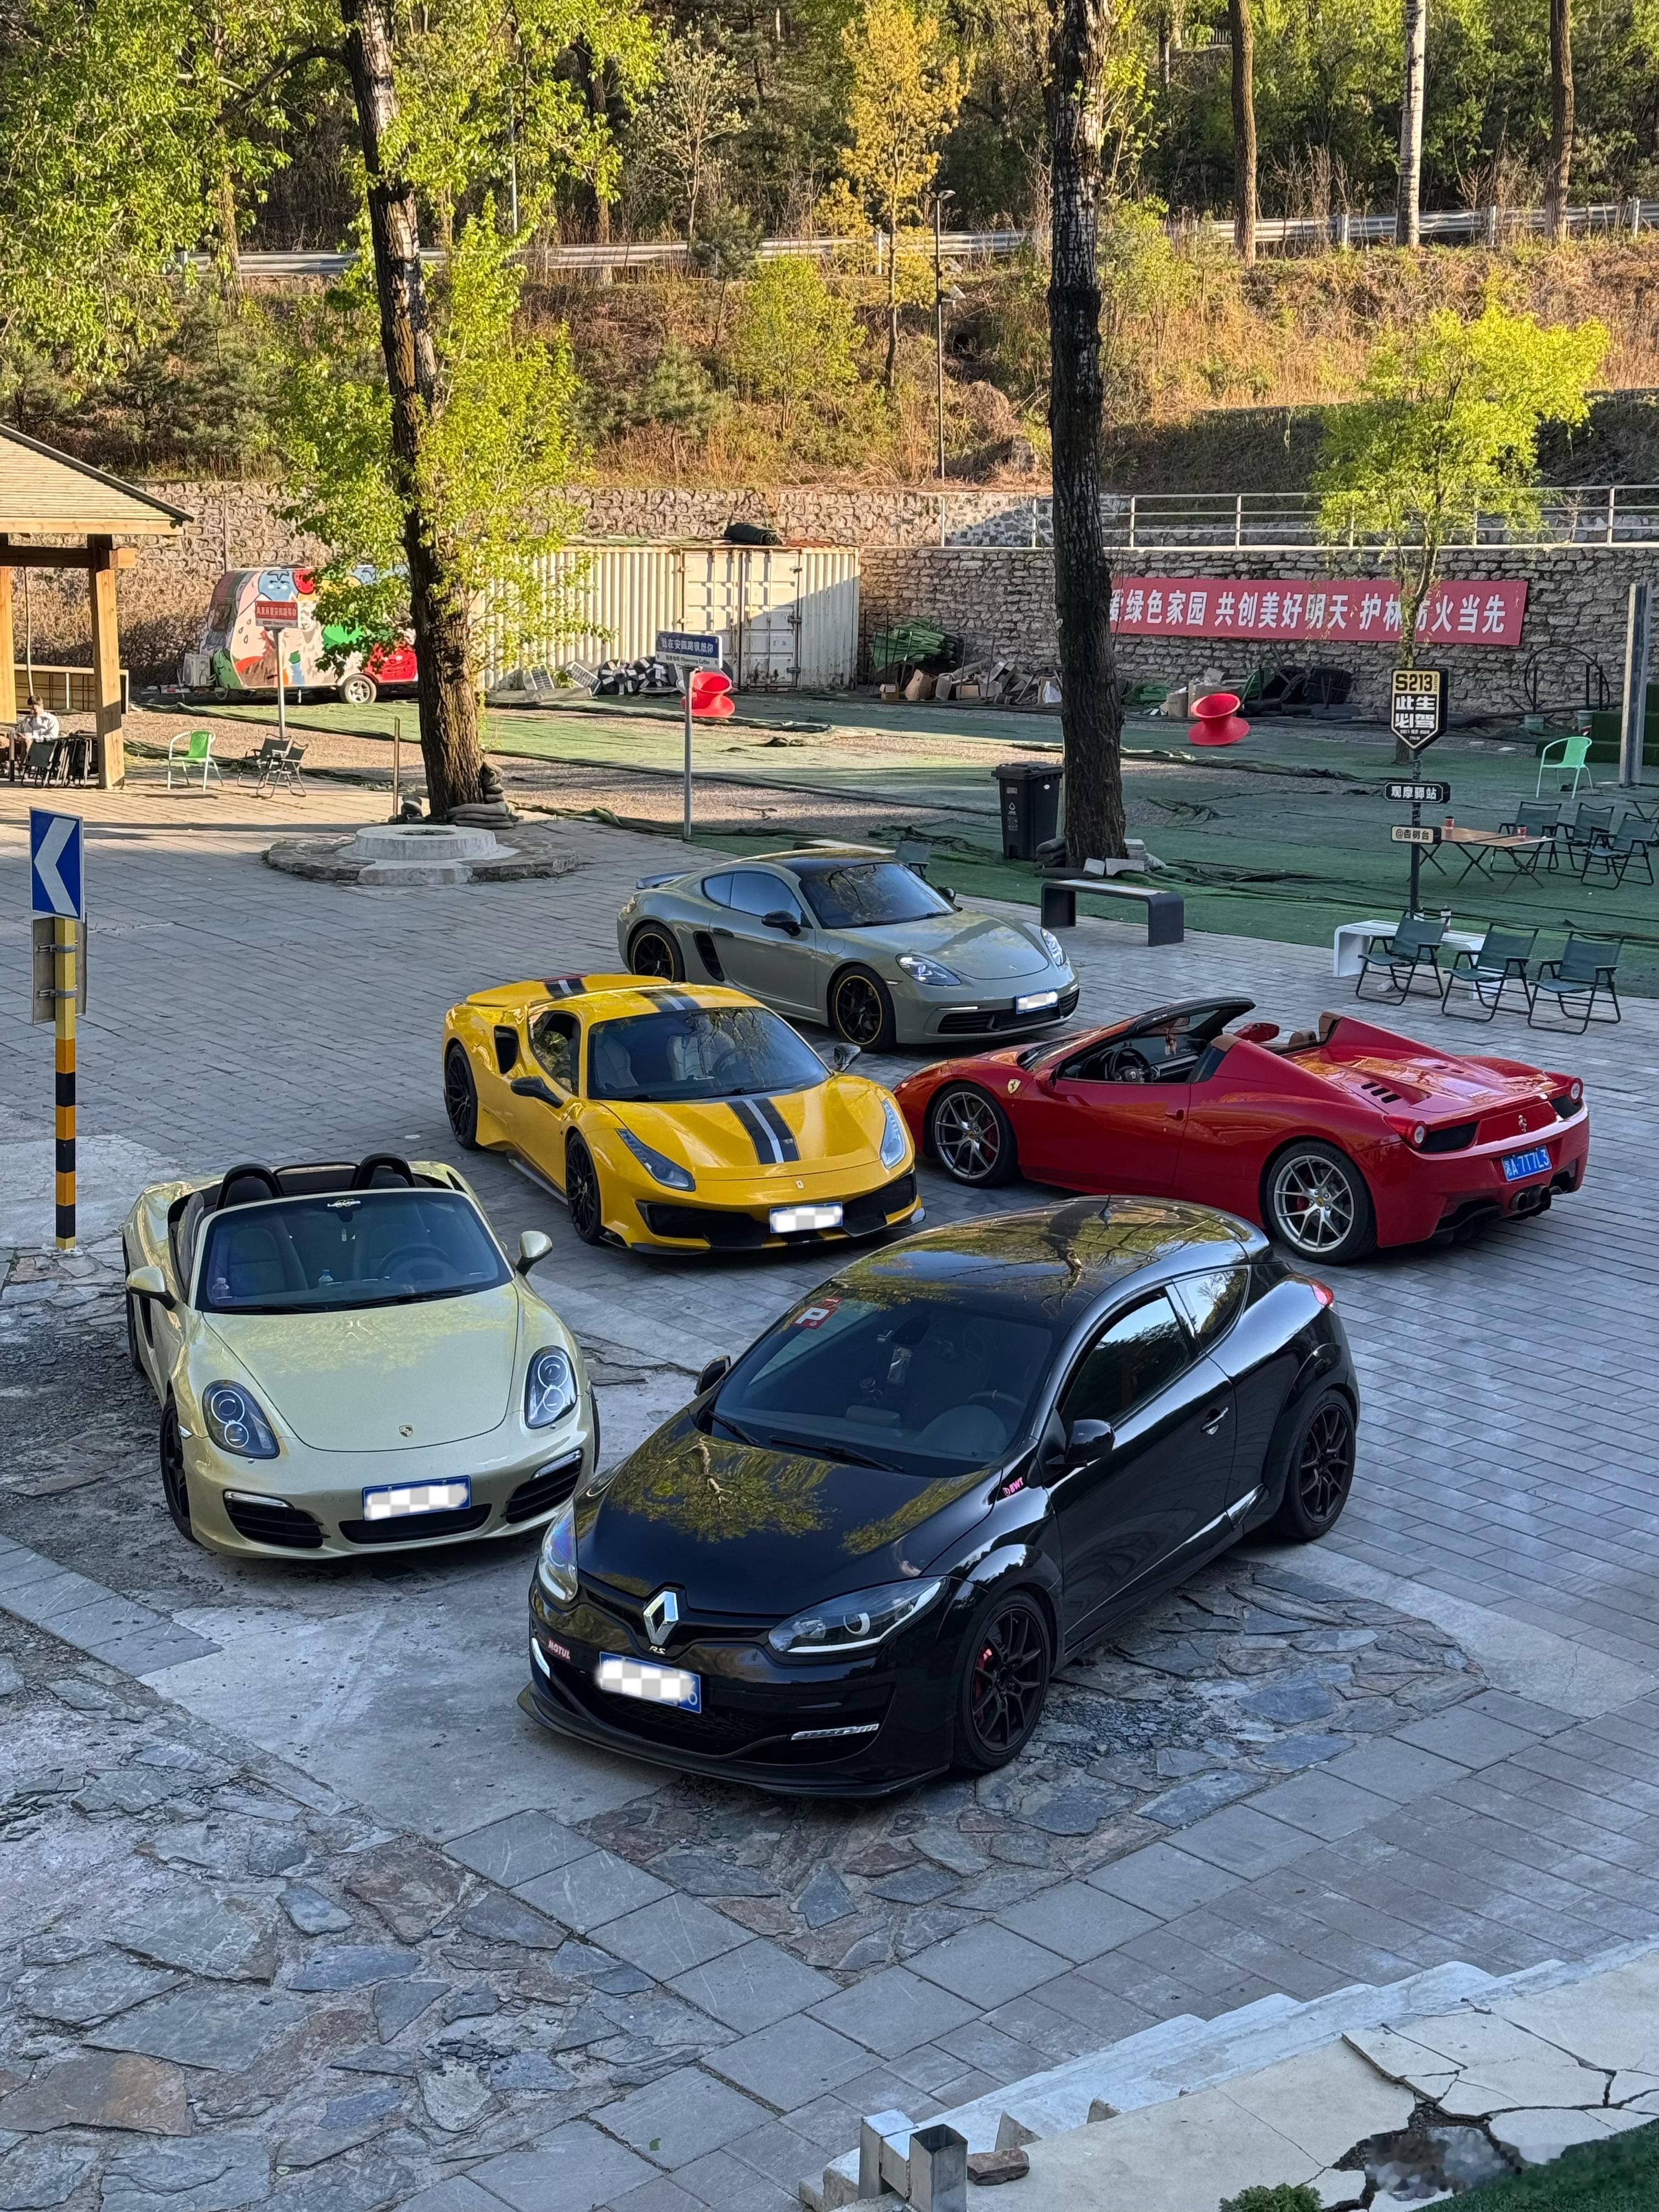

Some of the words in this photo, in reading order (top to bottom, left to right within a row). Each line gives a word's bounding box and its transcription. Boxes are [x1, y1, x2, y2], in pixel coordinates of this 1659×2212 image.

[1214, 591, 1348, 630] 共创美好明天
[1395, 674, 1432, 692] S213
[1395, 696, 1436, 710] 此生
[1395, 713, 1435, 729] 必驾
[1009, 1476, 1024, 1493] BWT
[548, 1640, 571, 1660] MOTUL
